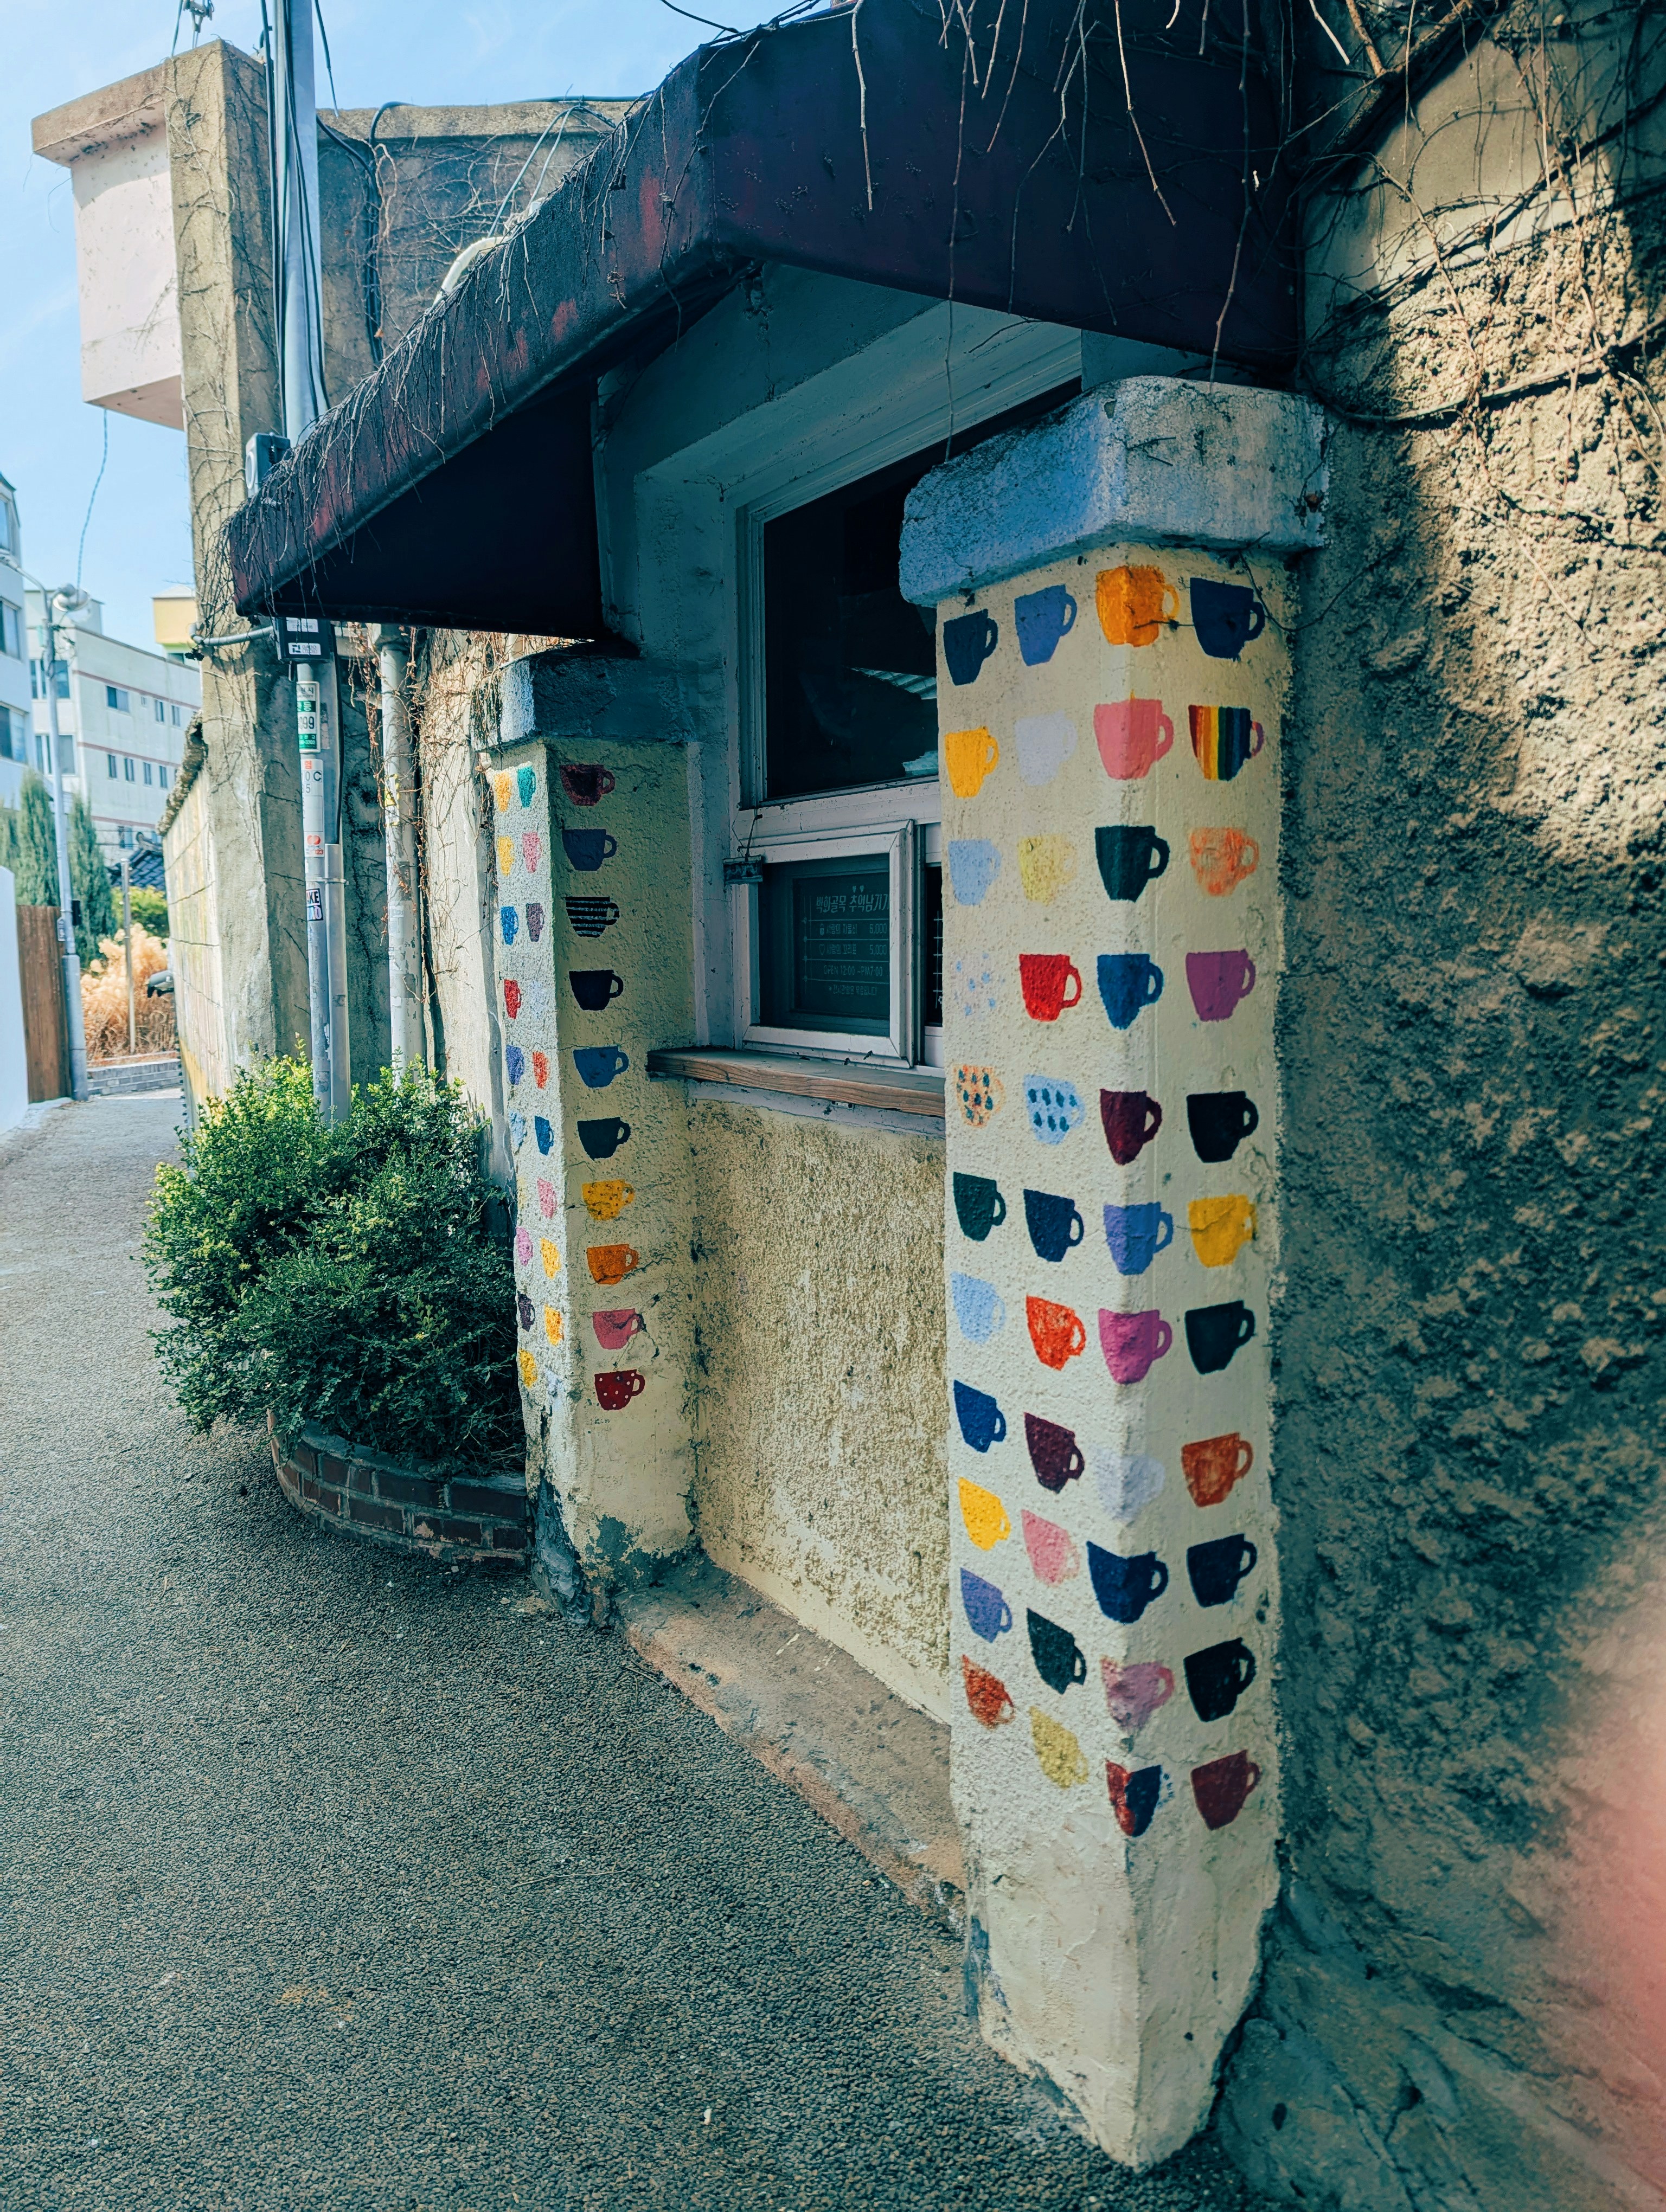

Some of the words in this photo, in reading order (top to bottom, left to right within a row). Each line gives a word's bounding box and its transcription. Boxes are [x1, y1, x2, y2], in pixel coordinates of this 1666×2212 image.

[869, 923, 887, 934] 6,000
[869, 944, 887, 956] 5,000
[823, 964, 838, 975] OPEN
[840, 965, 855, 975] 12:00
